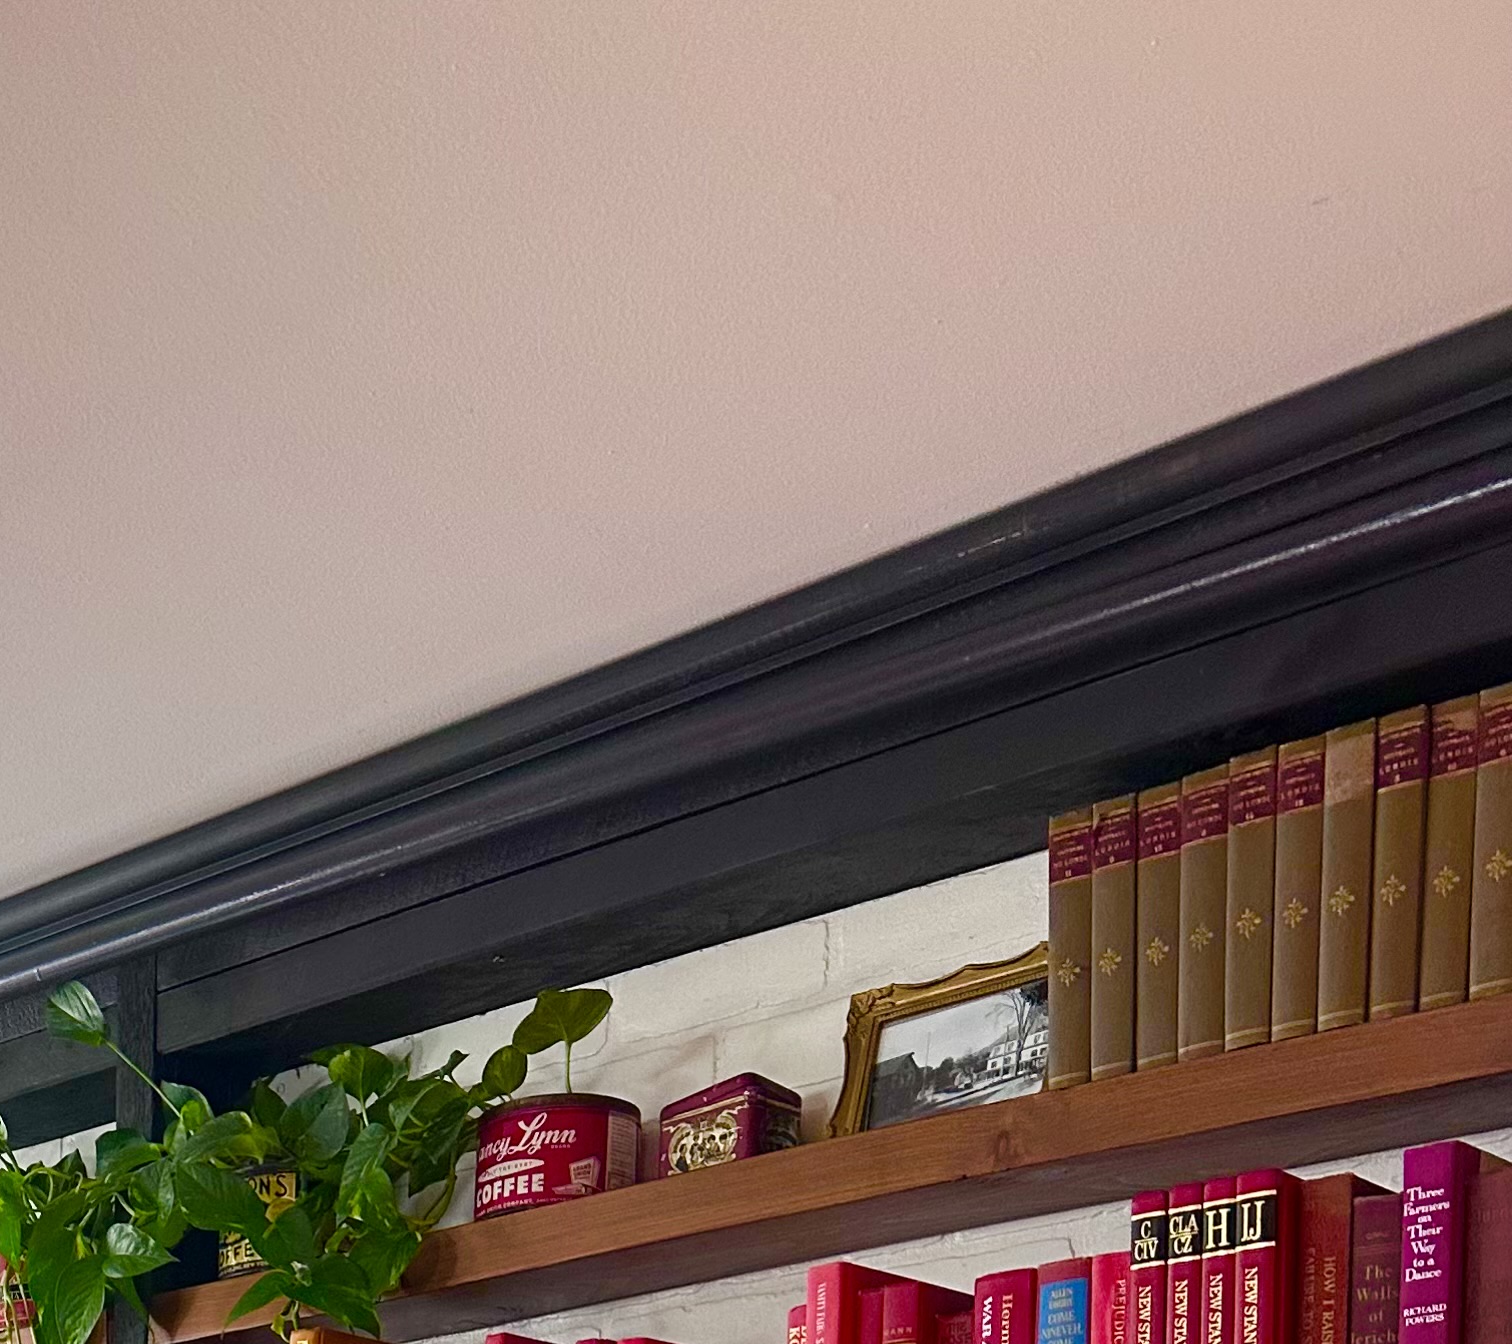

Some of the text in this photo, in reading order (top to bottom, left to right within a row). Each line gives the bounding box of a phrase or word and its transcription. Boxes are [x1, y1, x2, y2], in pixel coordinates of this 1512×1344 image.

[509, 1112, 577, 1155] Lynn
[476, 1173, 544, 1208] COFFEE
[1406, 1187, 1445, 1201] Three
[1241, 1200, 1263, 1241] IJ
[1403, 1201, 1450, 1217] Farmers
[1170, 1214, 1198, 1232] CLA
[1207, 1208, 1228, 1249] H
[1407, 1225, 1443, 1240] Their
[1135, 1240, 1158, 1260] CIV
[1173, 1235, 1193, 1253] CZ
[1411, 1240, 1436, 1255] Way
[1245, 1267, 1258, 1303] NEW
[1405, 1268, 1442, 1282] Dance
[1139, 1286, 1151, 1321] NEW
[1175, 1280, 1188, 1315] NEW
[1210, 1273, 1223, 1310] NEW
[982, 1296, 993, 1336] WAR
[1403, 1303, 1447, 1317] RICHARD
